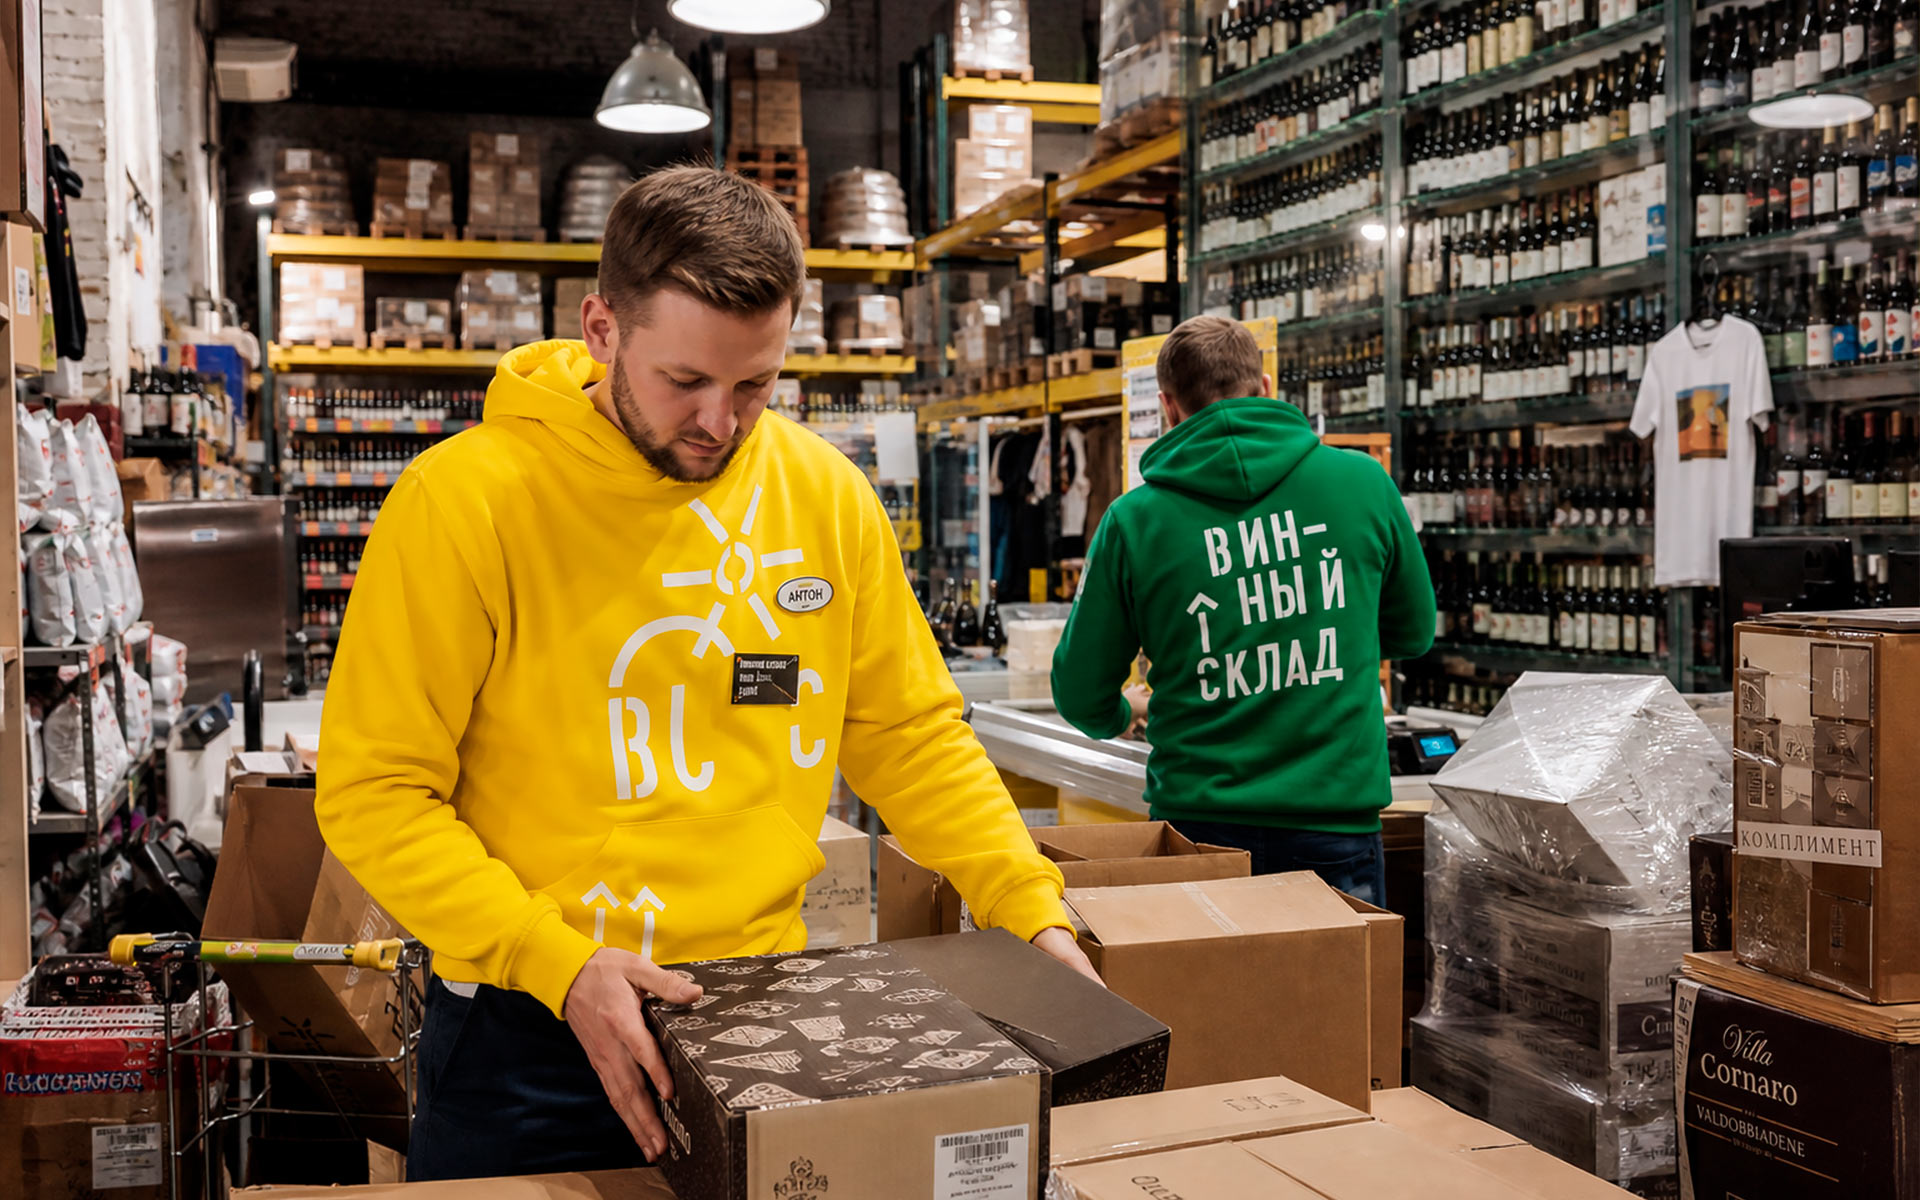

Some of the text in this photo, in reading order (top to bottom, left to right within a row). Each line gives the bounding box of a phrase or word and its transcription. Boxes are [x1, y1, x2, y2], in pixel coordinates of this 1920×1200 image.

[788, 588, 823, 603] АНТОН
[1237, 547, 1345, 625] НЫЙ
[1197, 627, 1343, 701] СКЛАД
[1740, 829, 1878, 857] КОМПЛИМЕНТ
[1722, 1023, 1774, 1066] Villa
[1700, 1052, 1798, 1107] Cornaro
[1696, 1104, 1806, 1158] VALDOBBIADENE
